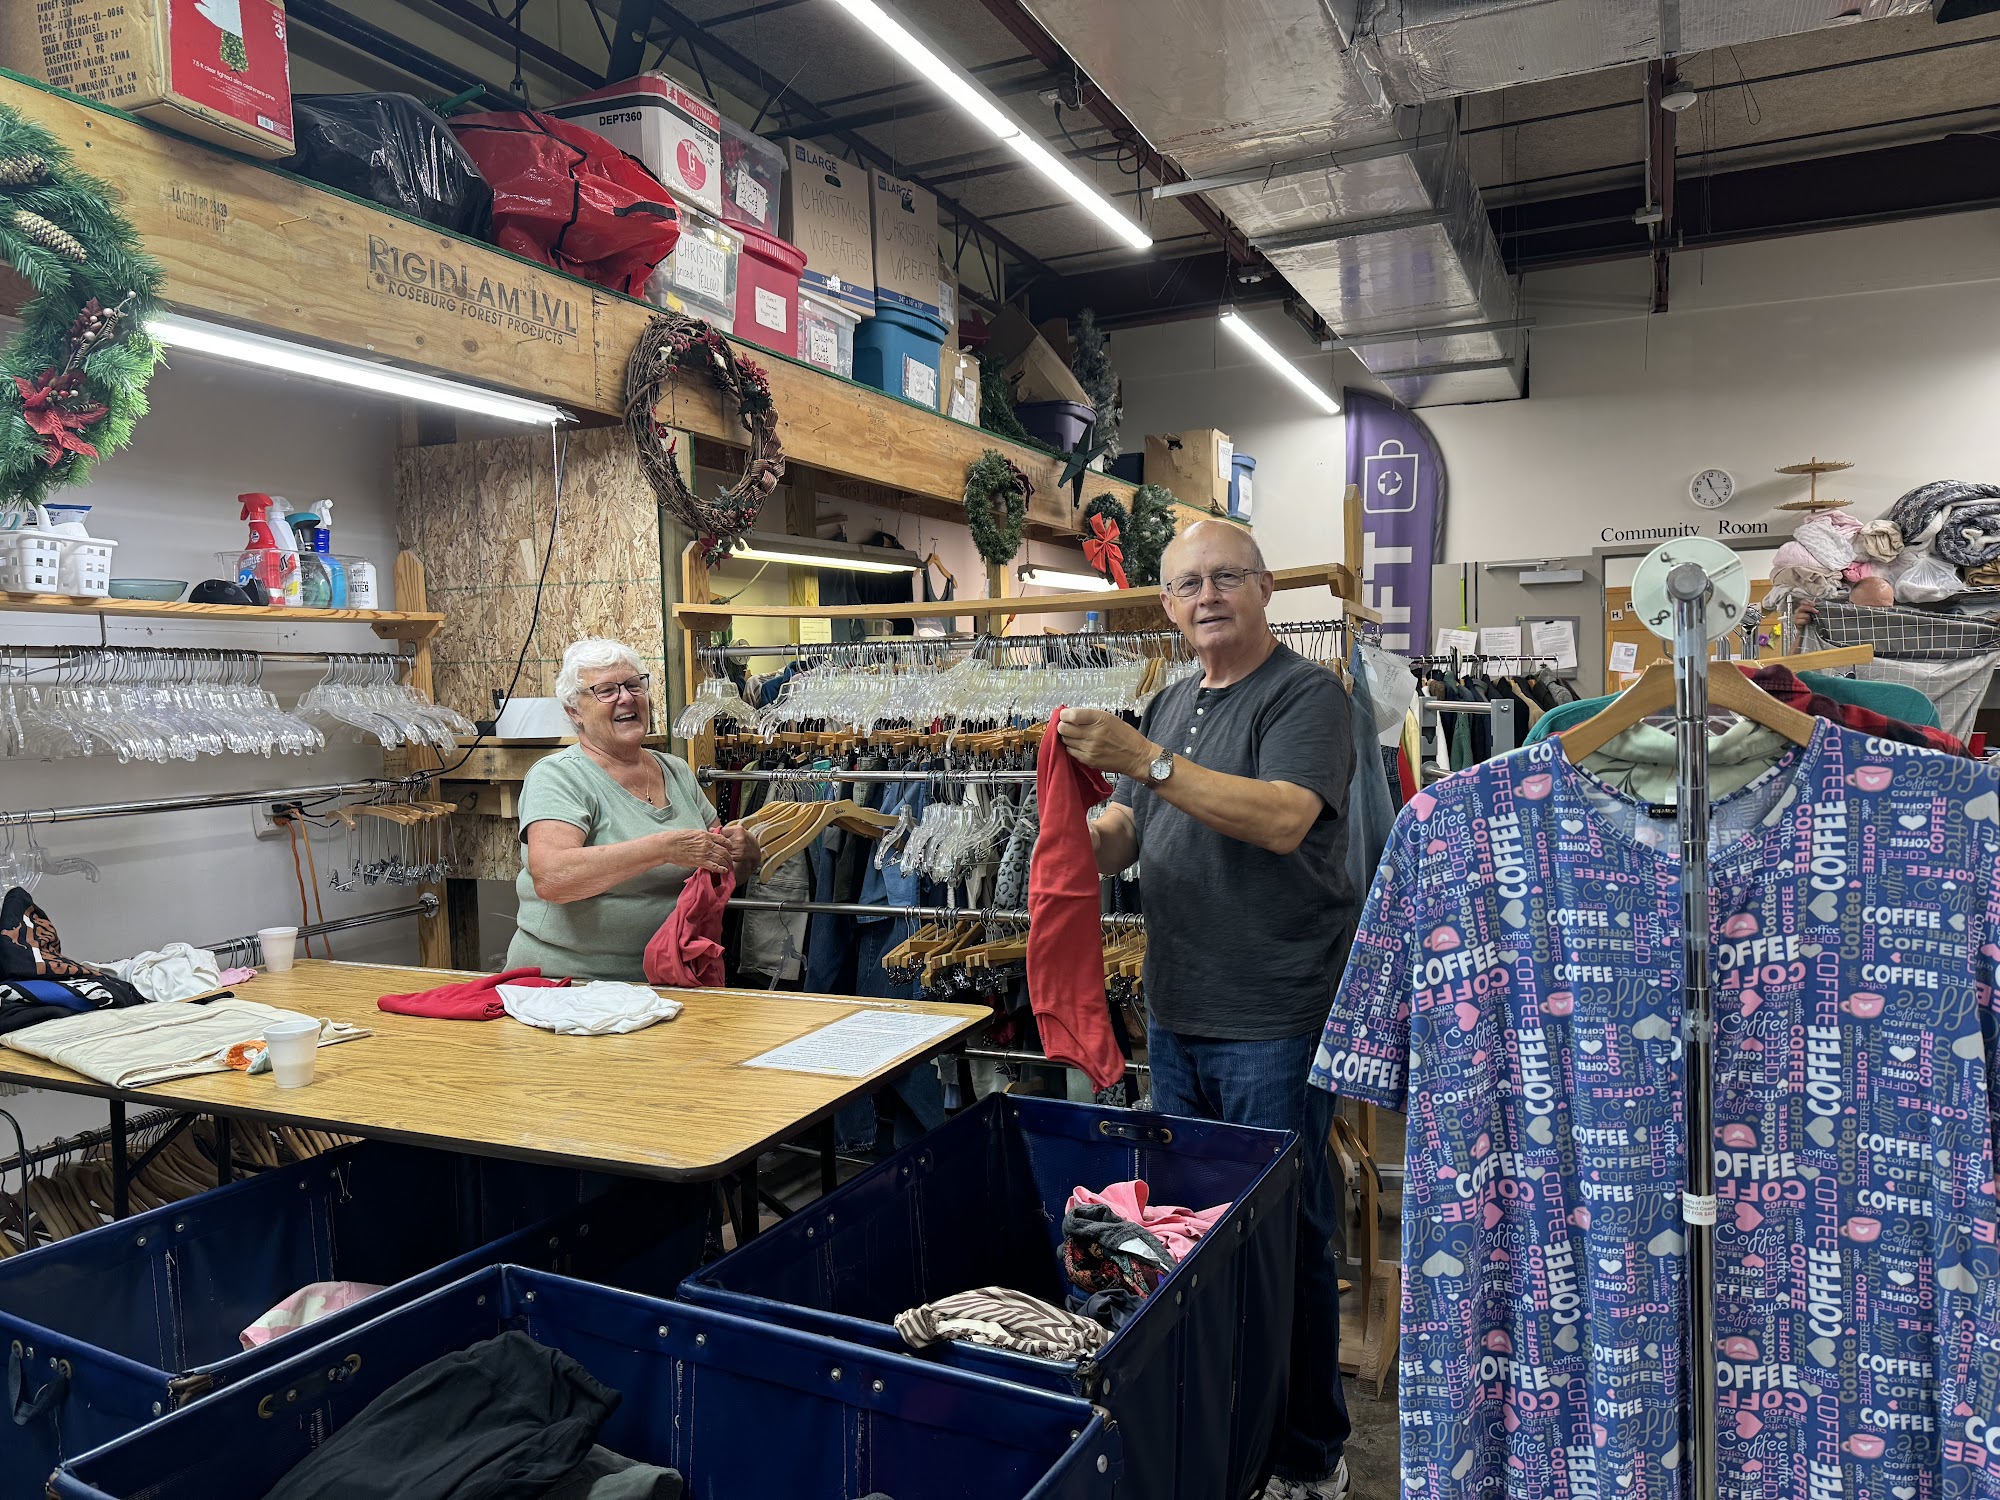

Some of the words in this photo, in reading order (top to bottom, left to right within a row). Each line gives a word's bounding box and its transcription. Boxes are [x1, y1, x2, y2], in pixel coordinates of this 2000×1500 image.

[37, 0, 59, 12] TARGET
[41, 34, 57, 45] STYLE
[42, 45, 60, 56] COLOR
[63, 39, 83, 51] GREEN
[45, 51, 81, 66] CASEPACK:
[86, 47, 91, 56] 1
[96, 44, 105, 53] PC
[47, 64, 73, 77] COUNTRY
[73, 61, 81, 70] OF
[83, 56, 108, 68] ORIGIN:
[110, 49, 131, 60] CHINA
[75, 77, 109, 93] DIMENSION
[115, 75, 123, 85] IN
[127, 71, 137, 82] CM
[89, 68, 97, 79] OF
[100, 65, 116, 76] 1522
[599, 112, 642, 126] DEPT360
[685, 98, 713, 125] CHRISTMAS
[692, 119, 710, 136] TREES
[806, 151, 838, 175] LARGE
[172, 187, 181, 204] LA
[887, 180, 913, 200] LARGE
[176, 205, 203, 226] LICENSE
[801, 182, 869, 236] CHRISTMAS
[881, 208, 937, 256] CHRISTMAS
[808, 222, 869, 270] WREATHS
[388, 280, 457, 312] ROSEBURG
[461, 303, 502, 327] FOREST
[507, 317, 564, 346] PRODUCTS
[531, 289, 577, 334] LVL
[1601, 522, 1701, 543] Community
[1718, 520, 1768, 535] Room
[350, 584, 369, 592] WATER
[1435, 776, 1480, 791] COFFEE
[1438, 785, 1476, 799] COFFEE
[1893, 775, 1938, 790] Coffee
[1472, 792, 1484, 818] coffee
[1407, 808, 1466, 844] Coffee
[1780, 811, 1796, 851] coffee
[1930, 797, 1947, 854] COFFEE
[1946, 799, 1968, 862] coffee
[1460, 826, 1476, 862] coffee
[1472, 818, 1494, 885] COFFEE
[1794, 803, 1812, 875] COFFEE
[1810, 800, 1848, 891] COFFEE
[1862, 825, 1876, 873] COFFEE
[1890, 838, 1930, 848] COFFEE
[1446, 826, 1467, 880] COFFEE
[1488, 811, 1528, 898] COFFEE
[1536, 832, 1550, 879] COFFEE
[1574, 867, 1640, 885] COFFEE
[1906, 865, 1975, 882] COFFEE
[1475, 896, 1489, 942] COFFEE
[1547, 908, 1609, 927] COFFEE
[1782, 885, 1795, 934] COFFEE
[1862, 906, 1941, 929] COFFEE
[1371, 922, 1402, 937] coffee
[1501, 931, 1530, 941] coffee
[1634, 913, 1650, 964] COFFEE
[1804, 924, 1840, 935] coffee
[1893, 927, 1924, 936] coffee
[1564, 936, 1634, 951] COFFEE
[1878, 936, 1967, 958] COFFEE
[1580, 952, 1630, 964] COFFEE
[1903, 953, 1961, 971] COFFEE
[1554, 964, 1614, 983] COFFEE
[1861, 964, 1938, 989] COFFEE
[1516, 956, 1540, 1029] COFFEE
[1816, 951, 1840, 1026] COFFEE
[1884, 1004, 1926, 1021] Coffee
[1351, 1037, 1404, 1061] COFFEE
[1605, 1022, 1621, 1076] COFFEE
[1789, 1025, 1804, 1093] COFFEE
[1331, 1050, 1400, 1090] COFFEE
[1504, 1029, 1522, 1096] COFFEE
[1518, 1028, 1554, 1115] COFFEE
[1806, 1026, 1842, 1116] COFFEE
[1432, 1078, 1491, 1104] COFFEE
[1592, 1086, 1655, 1098] COFFEE
[1418, 1091, 1442, 1150] COFFEE
[1898, 1096, 1968, 1120] COFFEE
[1443, 1106, 1470, 1172] COFFEE
[1571, 1125, 1629, 1146] COFFEE
[1857, 1132, 1933, 1160] COFFEE
[1455, 1152, 1527, 1198] COFFEE
[1528, 1246, 1549, 1311] COFFEE
[1545, 1239, 1581, 1324] COFFEE
[1790, 1243, 1806, 1311] COFFEE
[1808, 1247, 1843, 1337] COFFEE
[1857, 1353, 1933, 1378] COFFEE
[1860, 1407, 1934, 1432] COFFEE
